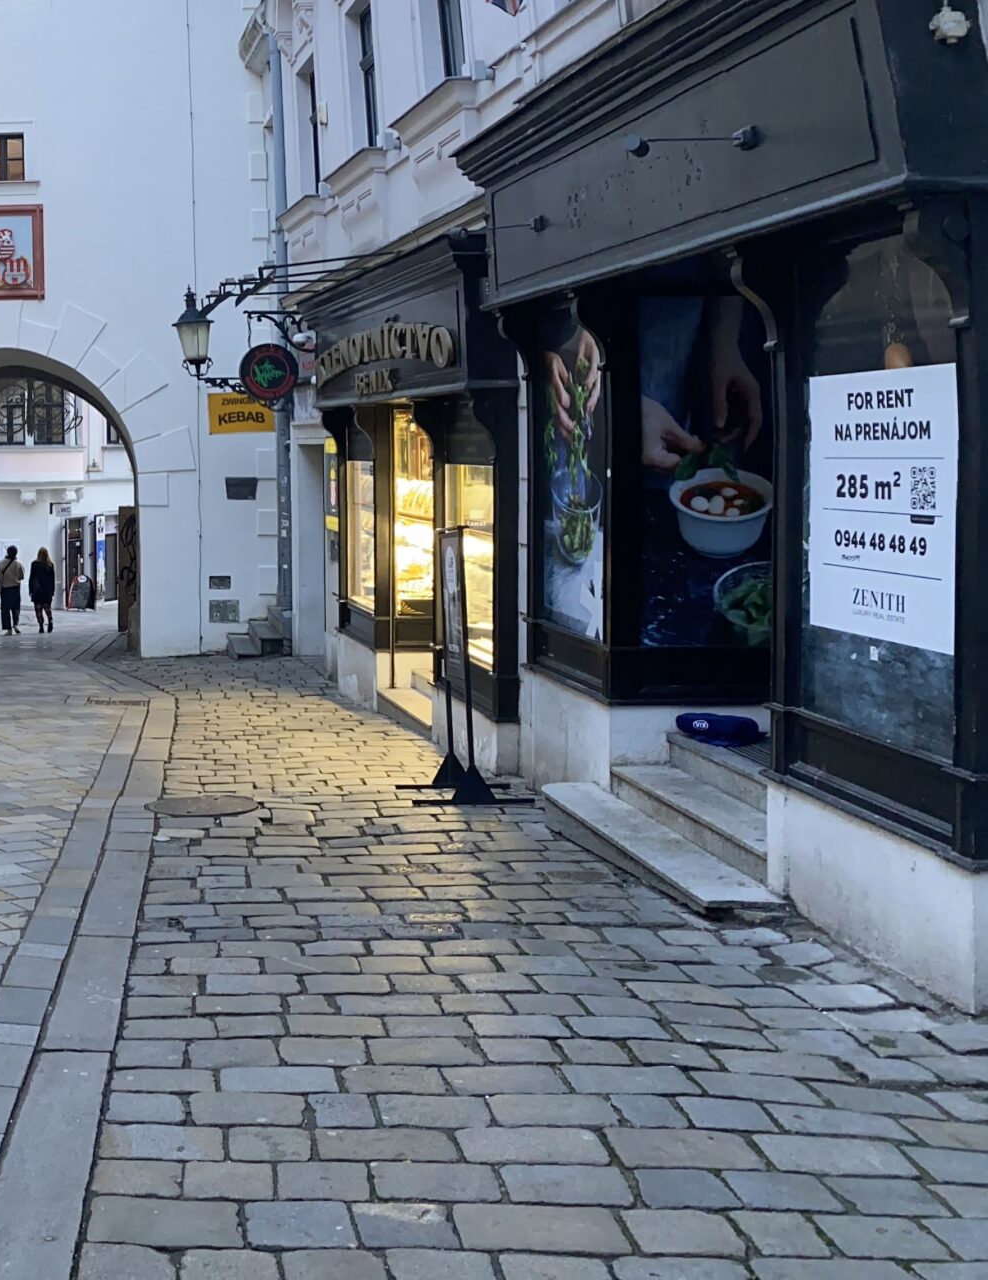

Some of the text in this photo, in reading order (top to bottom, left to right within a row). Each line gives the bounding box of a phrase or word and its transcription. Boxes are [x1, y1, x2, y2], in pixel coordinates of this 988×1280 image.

[847, 388, 914, 411] FOR RENT
[218, 411, 266, 426] KEBAB
[834, 417, 931, 441] NA PRENÁJOM
[836, 474, 868, 499] 285
[834, 529, 927, 556] 0944 48 48 49
[852, 587, 905, 613] ZENITH
